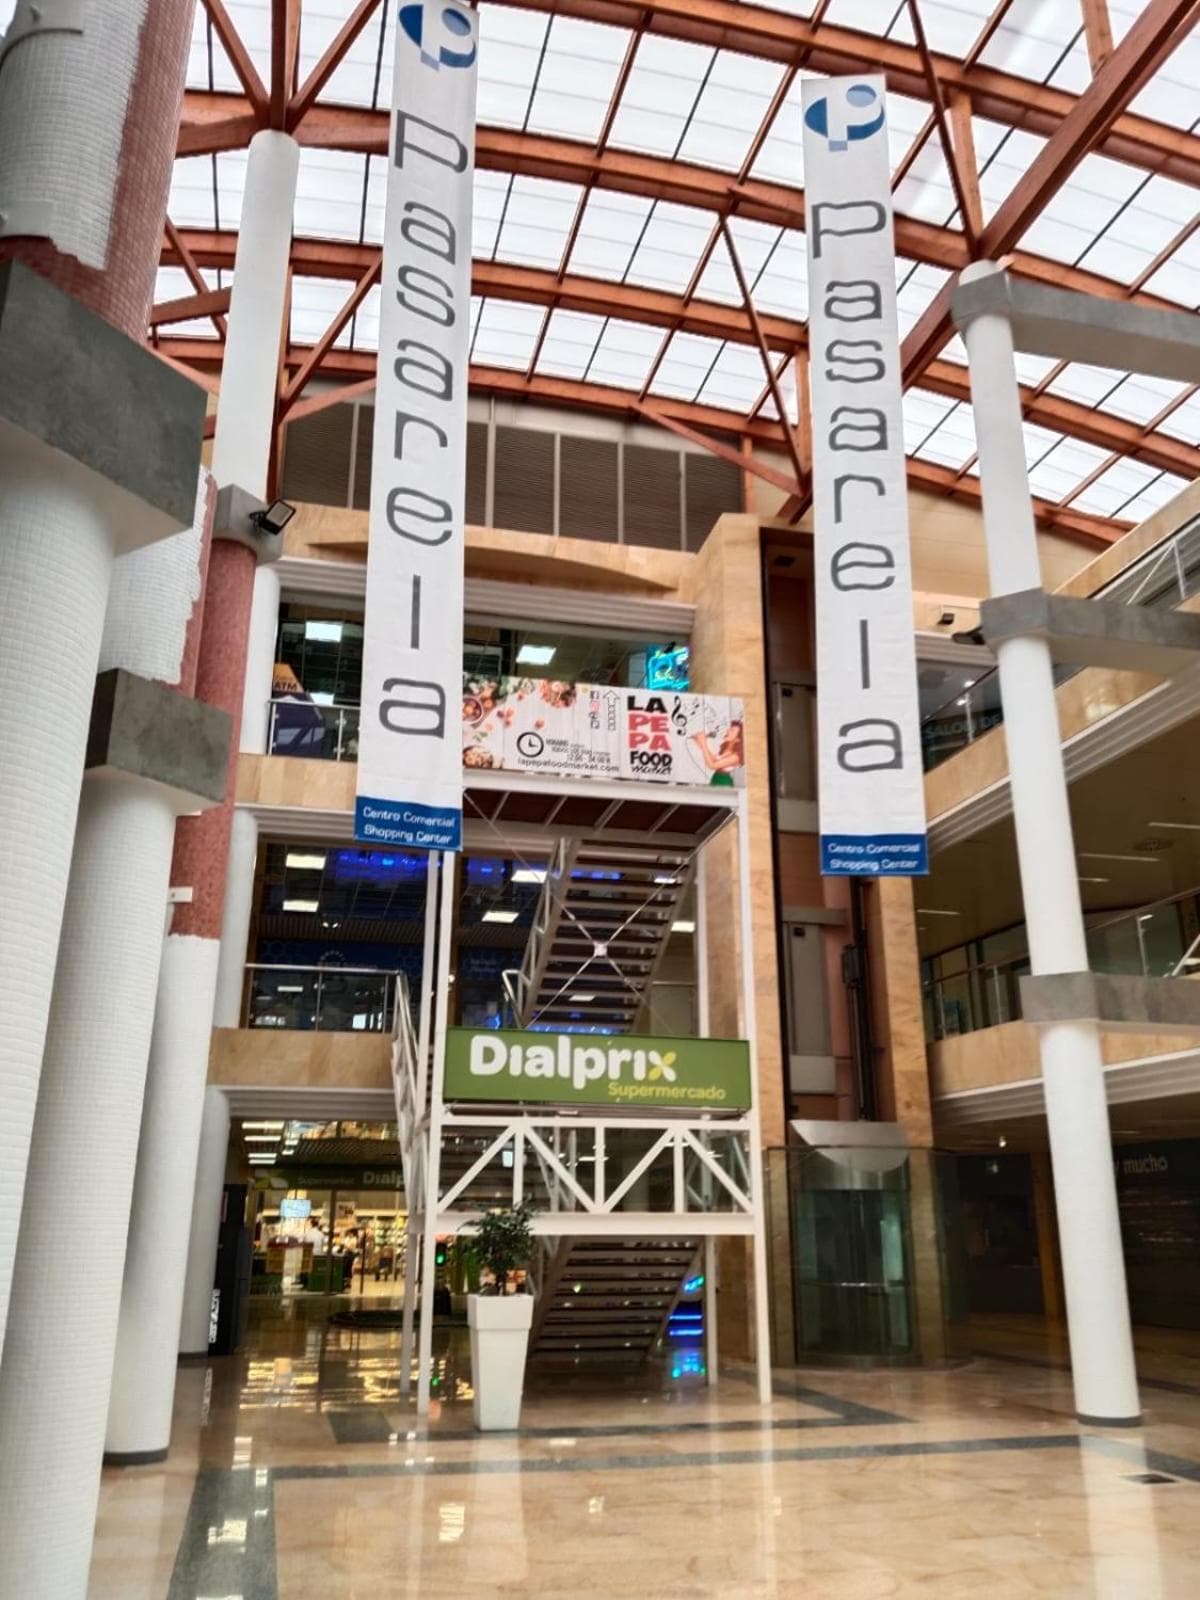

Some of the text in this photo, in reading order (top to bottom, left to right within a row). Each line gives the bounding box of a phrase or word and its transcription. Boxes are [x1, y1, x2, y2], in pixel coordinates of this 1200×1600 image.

[379, 109, 469, 739] Pasarela
[811, 200, 903, 773] Pasarela
[627, 695, 667, 713] LA
[628, 713, 670, 733] PE
[628, 732, 672, 751] PA
[630, 750, 673, 767] FOOD
[363, 806, 456, 828] Centro Comercial
[364, 824, 453, 844] Shopping Center
[828, 843, 920, 854] Centro Comercial
[830, 858, 919, 871] Shopping Center
[470, 1034, 677, 1090] Dialprix
[607, 1081, 727, 1100] Supermercado
[1123, 1154, 1168, 1176] mucho
[362, 1171, 406, 1188] Dialp
